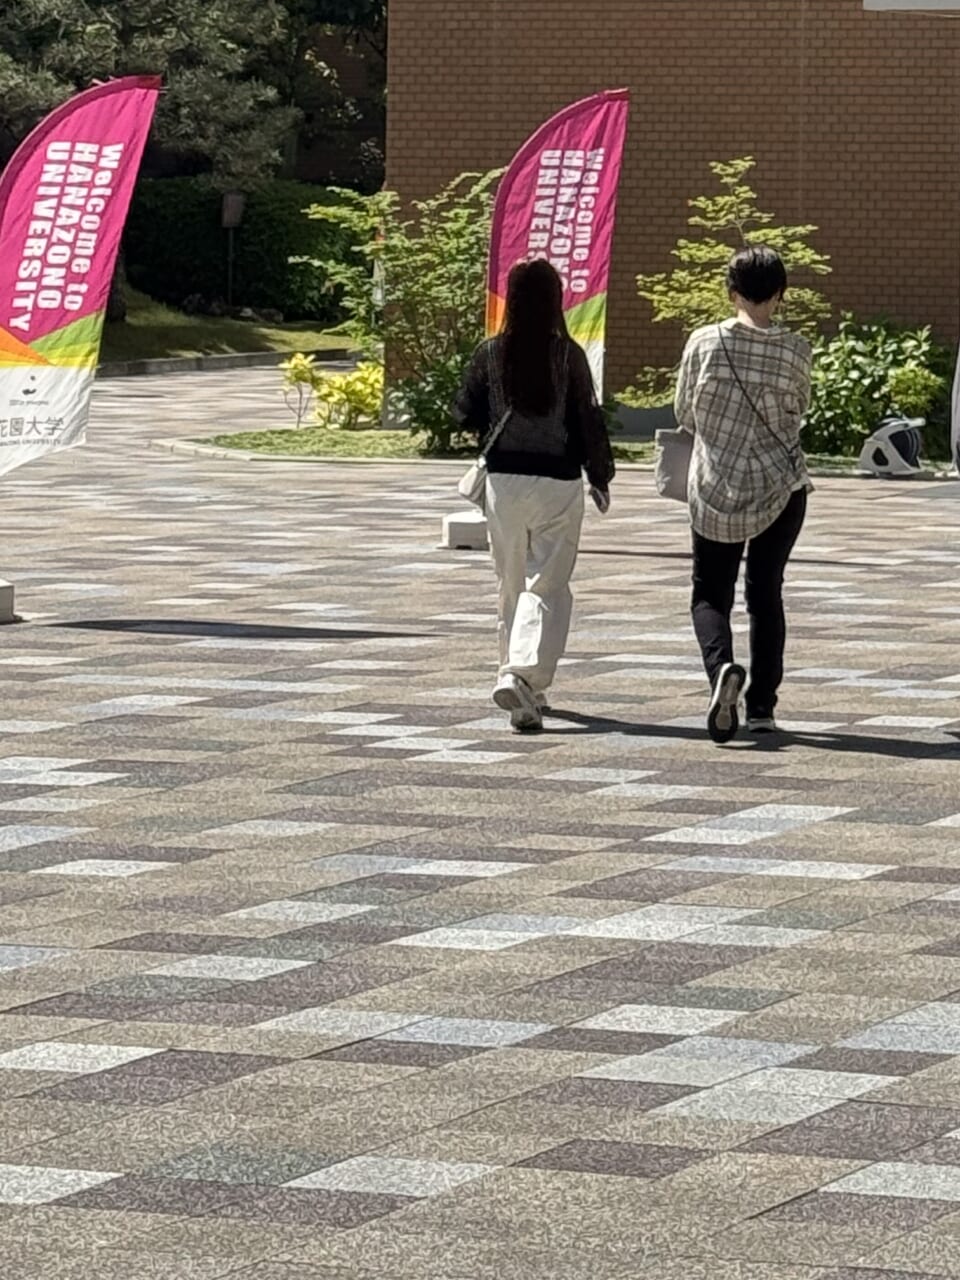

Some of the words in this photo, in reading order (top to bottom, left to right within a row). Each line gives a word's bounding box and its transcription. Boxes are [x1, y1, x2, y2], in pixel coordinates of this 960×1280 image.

[9, 141, 72, 331] UNIVERSITY
[37, 142, 100, 309] HANAZONO
[71, 143, 124, 274] Welcome
[572, 147, 605, 262] Welcome
[64, 283, 88, 311] to
[570, 269, 590, 293] to
